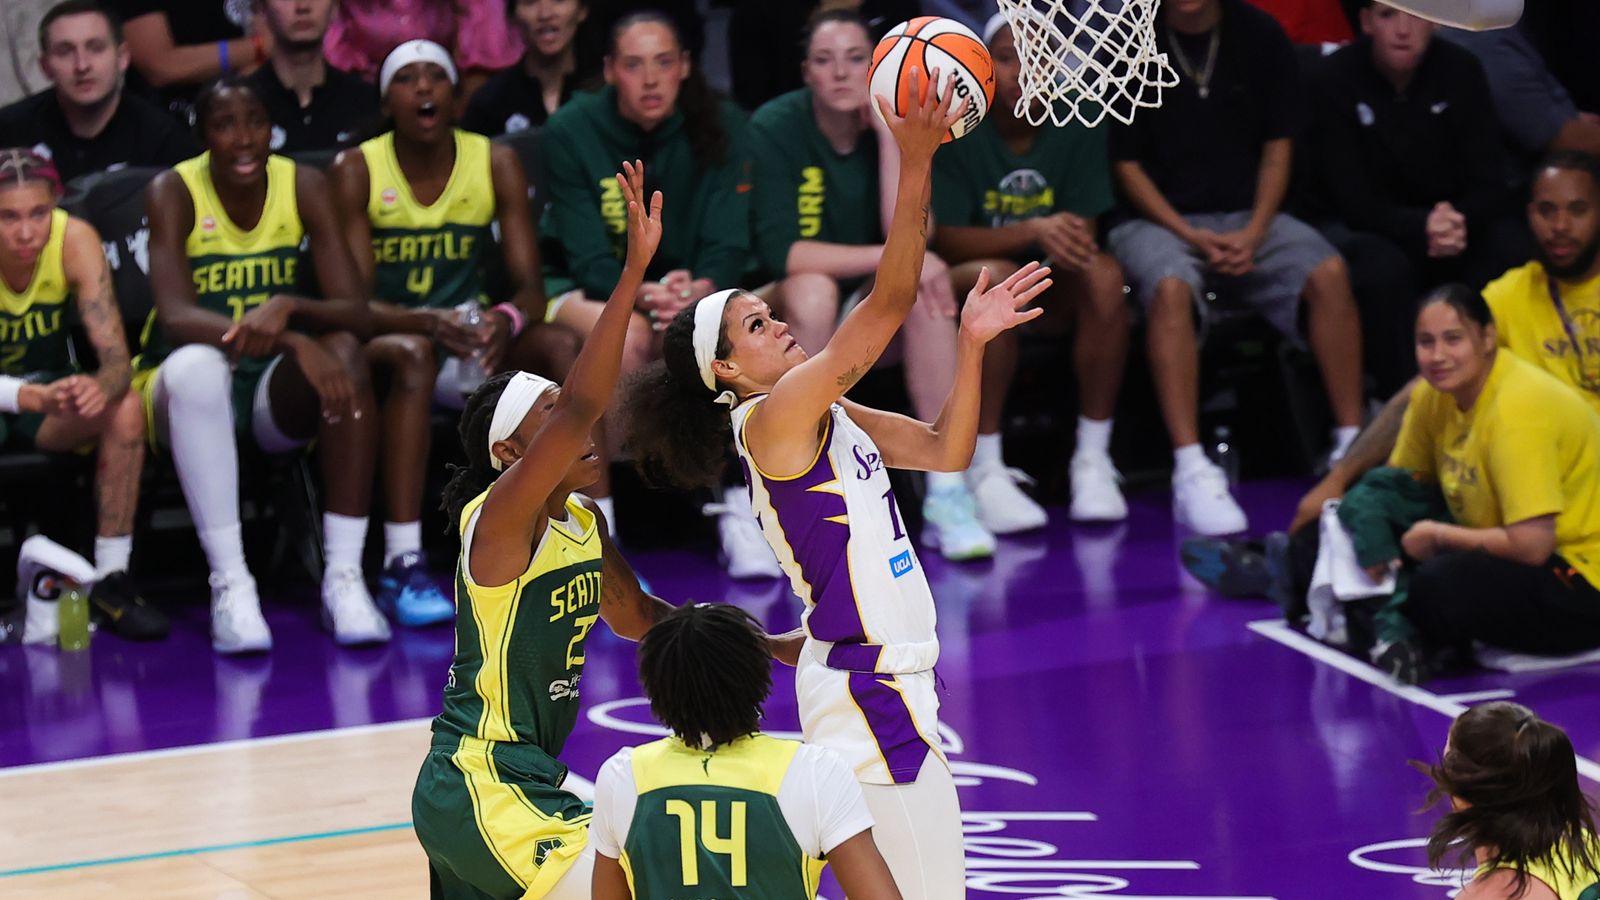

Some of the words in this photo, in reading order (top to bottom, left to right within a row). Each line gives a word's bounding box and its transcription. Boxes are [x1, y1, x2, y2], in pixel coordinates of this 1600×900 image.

[372, 231, 476, 263] SEATTLE
[192, 256, 298, 294] SEATTLE
[406, 265, 434, 297] 4
[665, 799, 747, 887] 14
